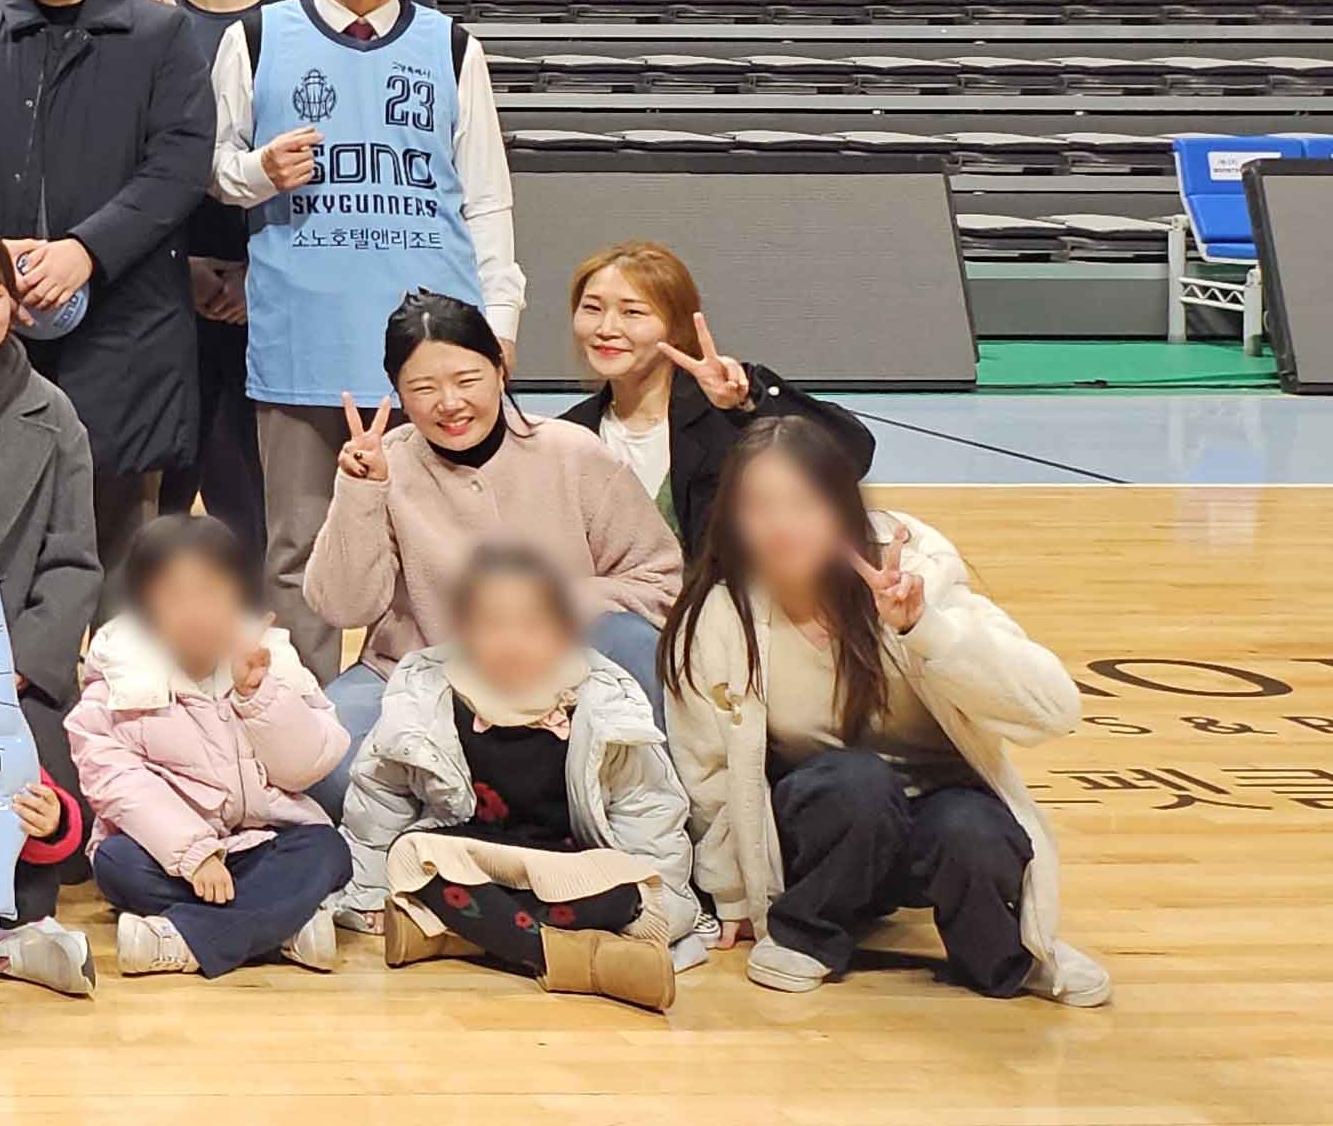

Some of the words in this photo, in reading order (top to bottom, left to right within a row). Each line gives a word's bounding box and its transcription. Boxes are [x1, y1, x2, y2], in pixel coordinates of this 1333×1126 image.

[385, 74, 434, 132] 23
[292, 194, 438, 218] SKYGUNNERS
[292, 228, 444, 251] 소노호텔앤리조트
